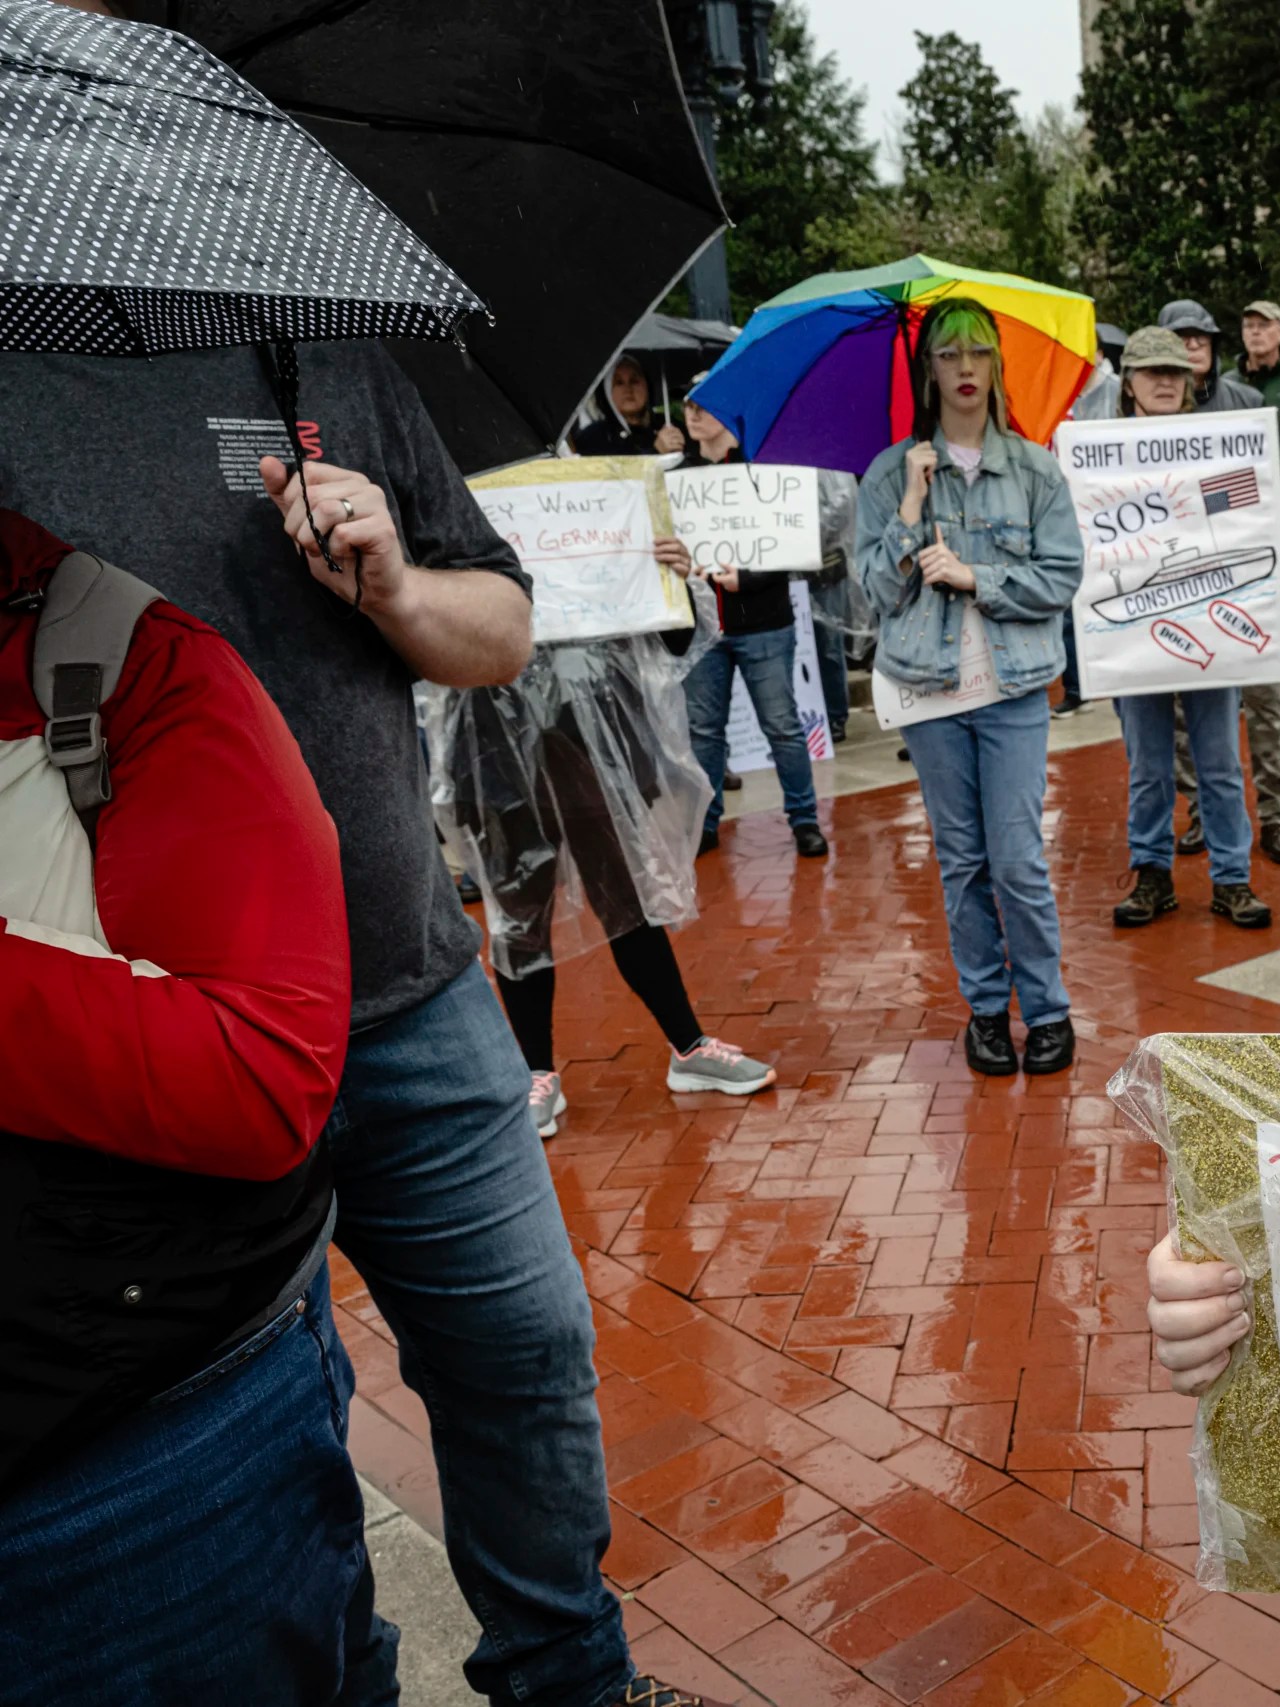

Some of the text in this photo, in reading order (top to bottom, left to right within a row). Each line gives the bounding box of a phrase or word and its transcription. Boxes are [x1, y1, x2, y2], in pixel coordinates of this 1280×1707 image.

[1071, 433, 1266, 469] SHIFT COURSE NOW
[537, 490, 608, 514] WANT
[756, 471, 802, 504] UP
[708, 515, 761, 532] SMELL
[773, 511, 806, 529] THE
[1092, 491, 1170, 544] SOS
[536, 527, 634, 552] GERMANY
[693, 536, 779, 569] COUP
[1124, 567, 1236, 617] CONSTITUTION
[1214, 605, 1261, 641] TRUMP
[1157, 625, 1196, 655] DOGE
